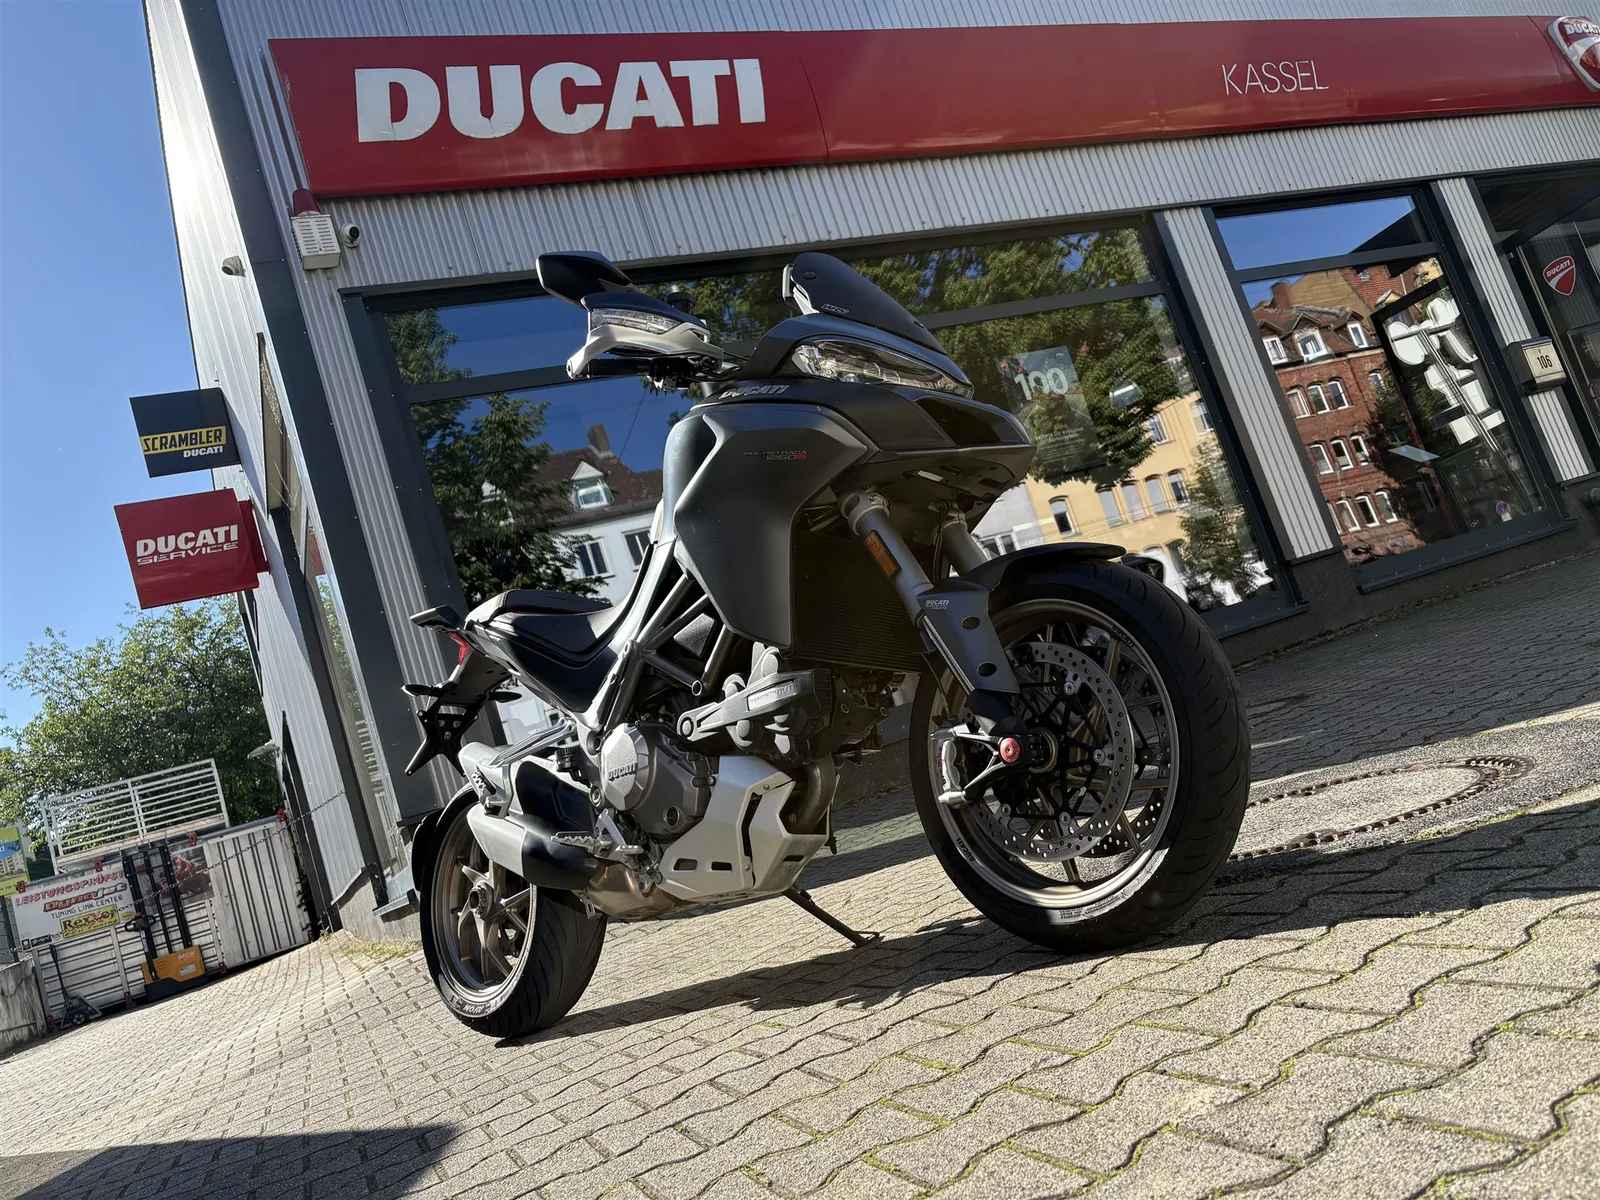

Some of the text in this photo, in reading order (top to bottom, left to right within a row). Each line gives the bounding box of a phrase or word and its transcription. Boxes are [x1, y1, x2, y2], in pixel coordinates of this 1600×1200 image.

[1564, 23, 1600, 35] DUCAT
[1221, 60, 1329, 95] KASSEL
[355, 58, 766, 142] DUCATI
[1546, 260, 1571, 278] DUCATI
[1537, 355, 1552, 369] 106
[719, 384, 790, 399] DUCATI
[1014, 368, 1069, 400] 100
[142, 428, 223, 452] SCRAMBLER
[183, 445, 223, 458] DUCATI
[136, 524, 238, 557] DUCATI
[137, 542, 238, 566] SERVICE
[956, 837, 976, 862] DUCATI
[15, 870, 125, 906] LEISTUNGSPRÜFST
[51, 894, 123, 919] TUNING LINK CENTER
[463, 1004, 484, 1014] AVON
